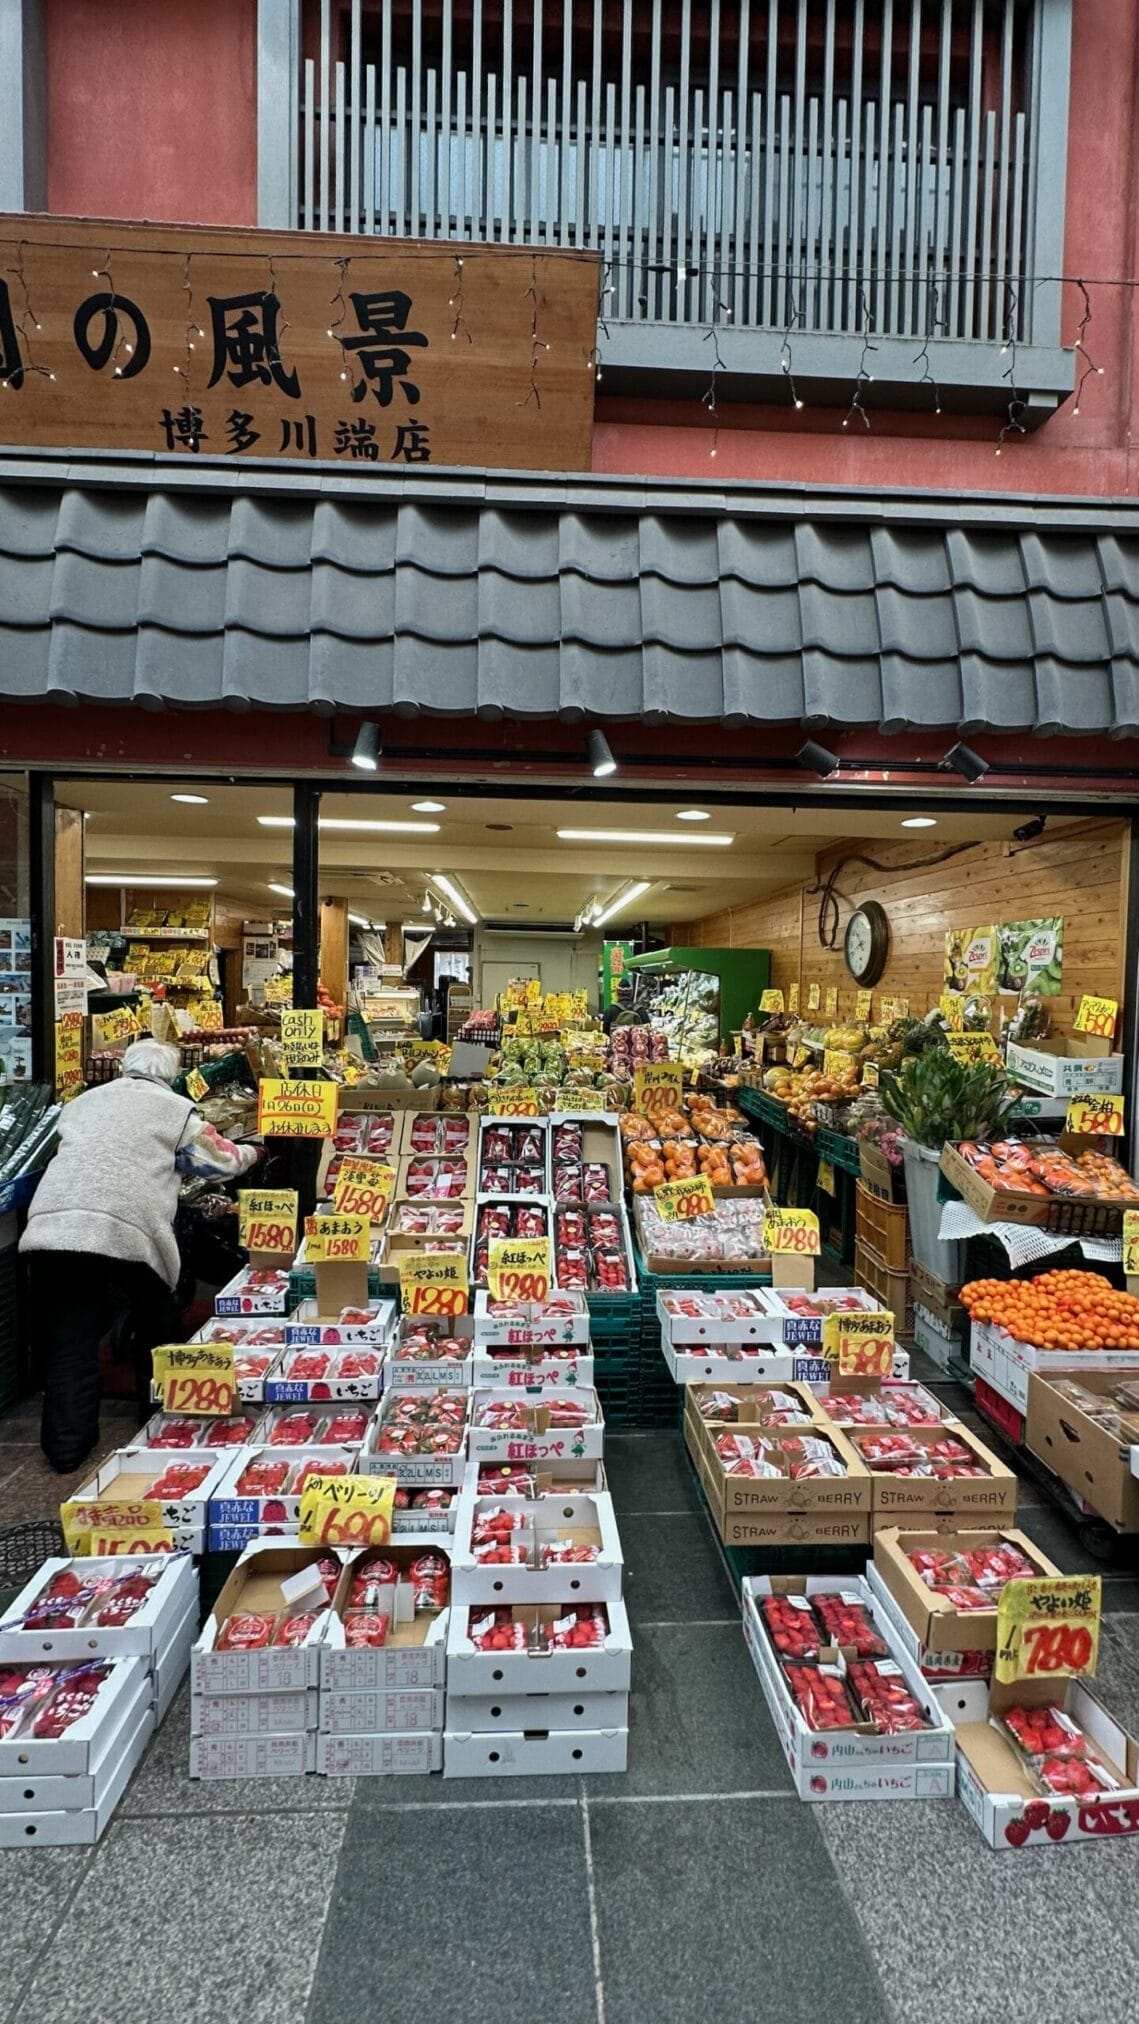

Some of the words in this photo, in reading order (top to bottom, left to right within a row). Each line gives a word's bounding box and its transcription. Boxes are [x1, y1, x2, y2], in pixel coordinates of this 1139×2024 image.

[159, 406, 432, 463] 博多川端店
[280, 1082, 321, 1097] 店休日
[269, 1120, 332, 1134] お休みします
[1079, 1111, 1122, 1134] 580
[249, 1198, 294, 1213] 紅ほっぺ
[335, 1184, 386, 1217] 1580
[676, 1193, 711, 1217] 980
[319, 1221, 363, 1236] あまおう
[247, 1223, 294, 1250] 1580
[772, 1227, 819, 1253] 1280
[326, 1239, 358, 1257] 1580
[501, 1249, 546, 1265] 紅ほっぺ
[413, 1265, 459, 1280] やよい姫
[499, 1272, 548, 1302] 1280
[254, 1301, 281, 1311] いちご
[412, 1286, 469, 1316] 1280
[786, 1320, 820, 1331] 真赤な
[291, 1335, 318, 1344] JEWEL
[347, 1329, 381, 1342] いちご
[508, 1328, 557, 1344] 紅ほっぺ
[785, 1331, 820, 1341] JEWEL
[433, 1372, 438, 1380] L
[440, 1372, 446, 1380] M
[448, 1371, 454, 1380] S
[508, 1370, 559, 1387] 紅ほっぺ
[166, 1377, 232, 1411] 1280
[275, 1392, 304, 1401] JEWEL
[337, 1383, 372, 1399] いちご
[508, 1441, 565, 1460] 紅ほっぺ
[417, 1468, 423, 1477] L
[425, 1468, 433, 1477] M
[434, 1468, 441, 1477] S
[734, 1492, 779, 1505] STRAW
[818, 1492, 862, 1504] BERRY
[880, 1491, 924, 1504] STRAW
[963, 1492, 1007, 1503] BERRY
[220, 1501, 254, 1513] 真赤な
[76, 1504, 150, 1527] 特売品
[219, 1512, 254, 1523] JEWEL
[732, 1525, 777, 1538] STRAW
[815, 1525, 860, 1537] BERRY
[1029, 1589, 1092, 1612] やよい姫
[1024, 1624, 1093, 1674] 780
